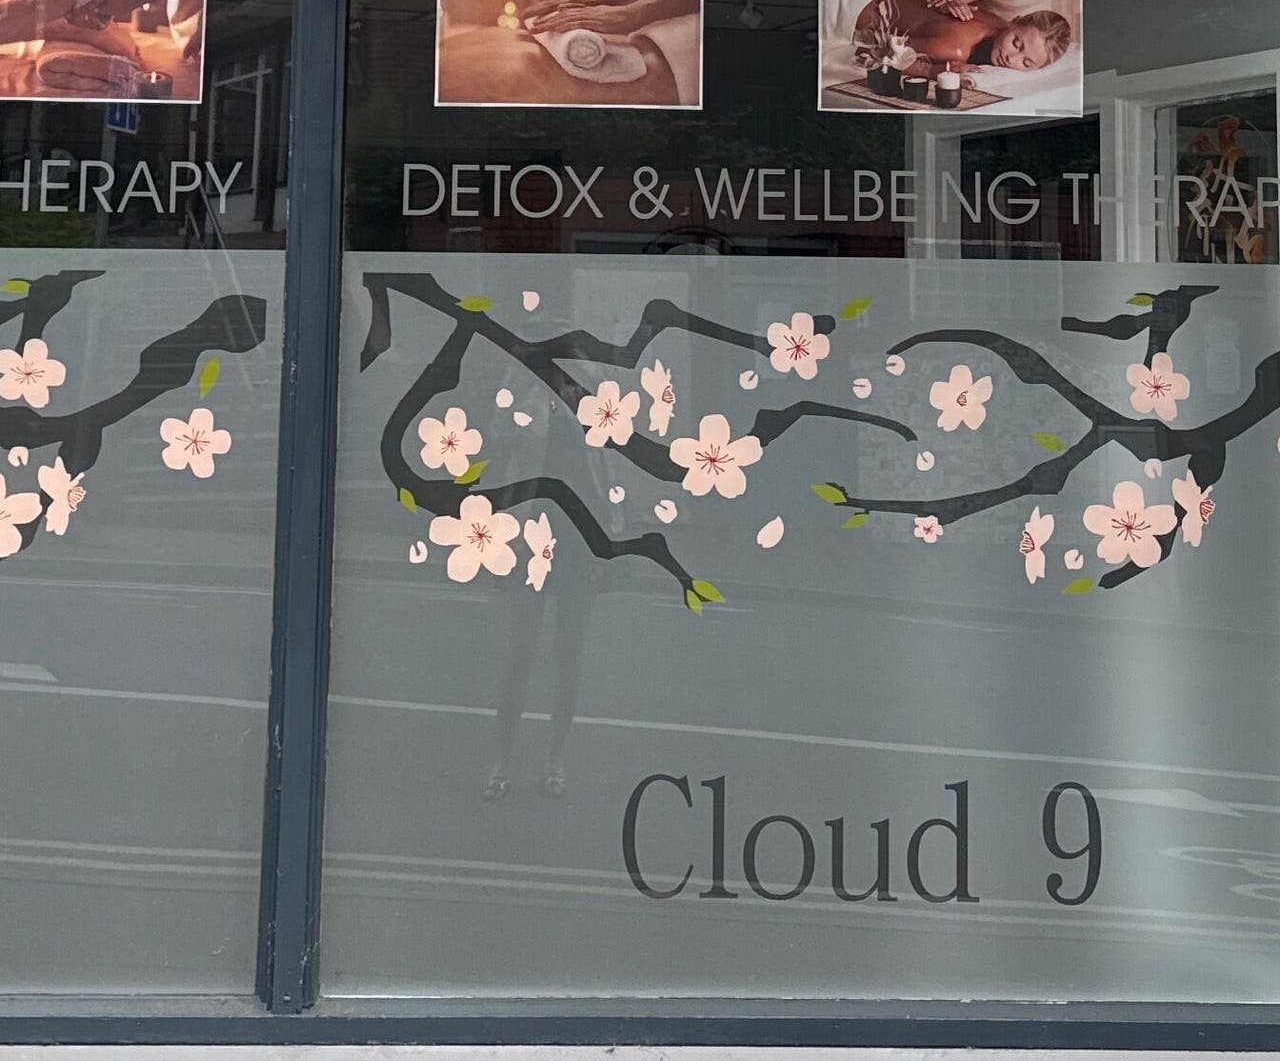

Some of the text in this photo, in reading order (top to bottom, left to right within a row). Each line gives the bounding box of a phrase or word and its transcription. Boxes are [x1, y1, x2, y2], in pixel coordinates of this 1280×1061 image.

[402, 162, 605, 221] DETOX
[626, 164, 672, 221] &
[693, 166, 1041, 226] WELLBENG
[621, 773, 1103, 906] Cloud 9
